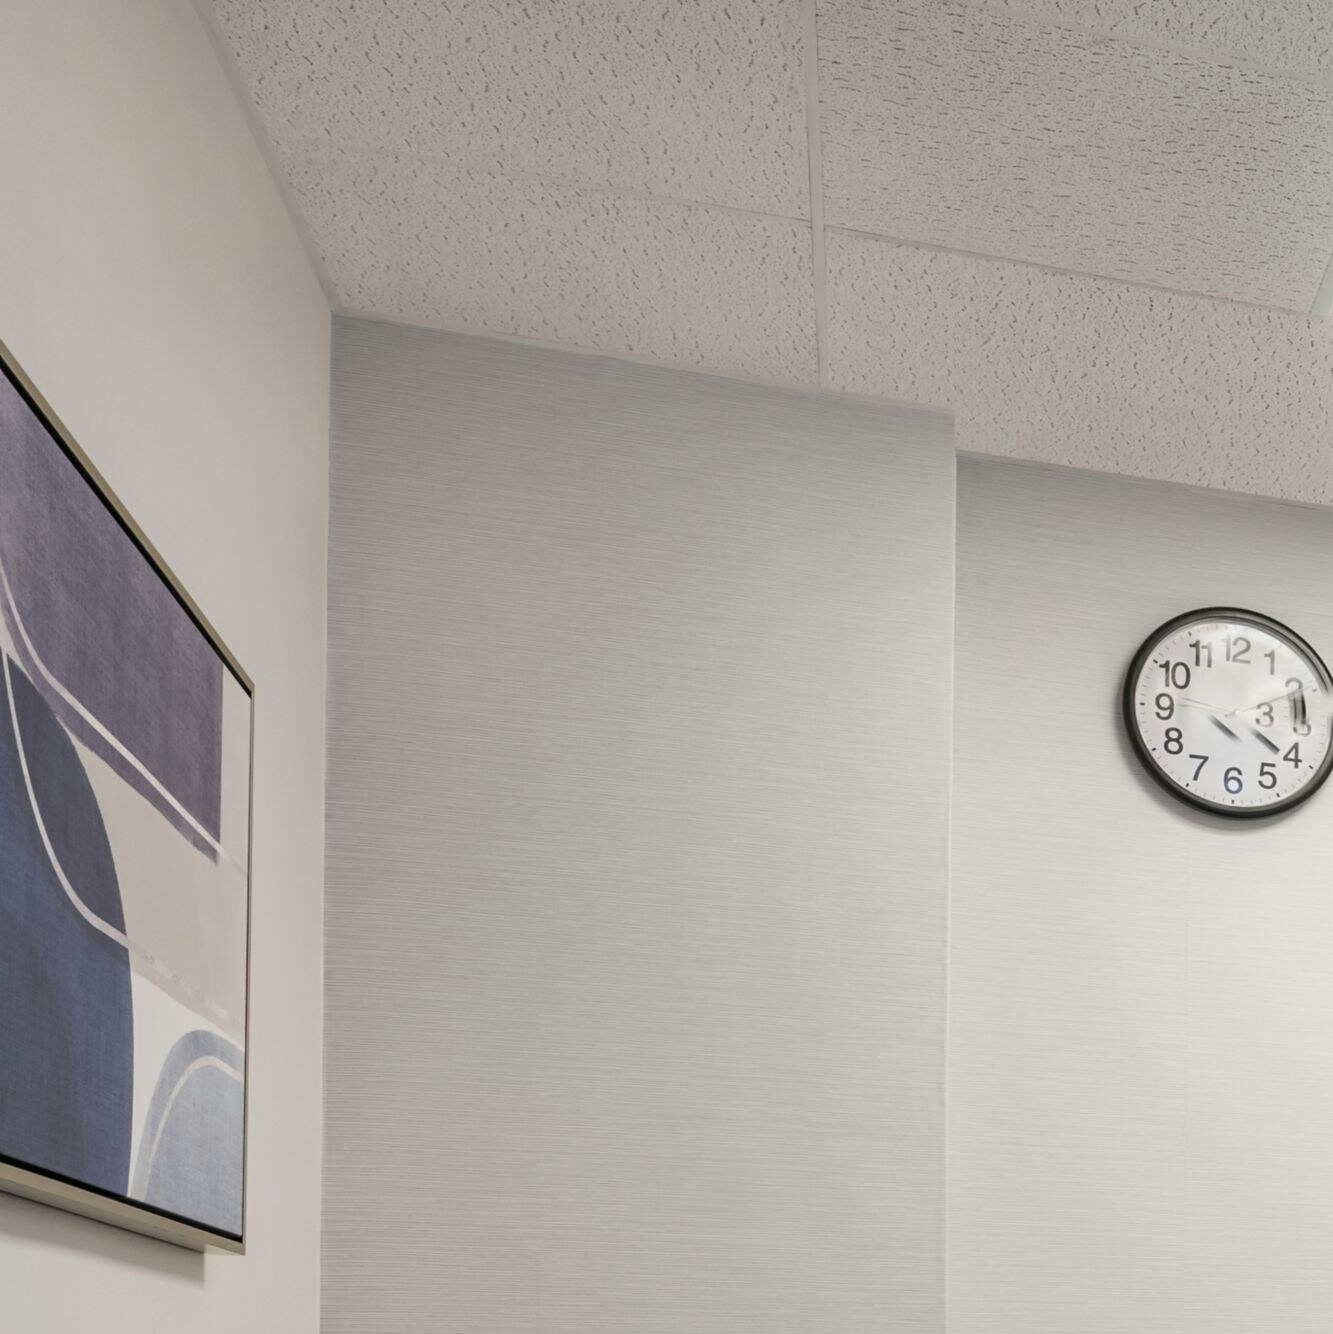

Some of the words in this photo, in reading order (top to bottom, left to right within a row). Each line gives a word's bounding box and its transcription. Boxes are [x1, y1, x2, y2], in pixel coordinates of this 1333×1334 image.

[1189, 640, 1212, 668] 11
[1221, 637, 1251, 664] 12
[1264, 650, 1275, 675] 1
[1159, 660, 1190, 689] 10
[1155, 693, 1174, 720] 9
[1255, 702, 1274, 728] 3
[1164, 728, 1183, 755] 8
[1189, 754, 1209, 781] 7
[1283, 743, 1302, 768] 4
[1224, 767, 1243, 794] 6
[1258, 763, 1277, 789] 5
